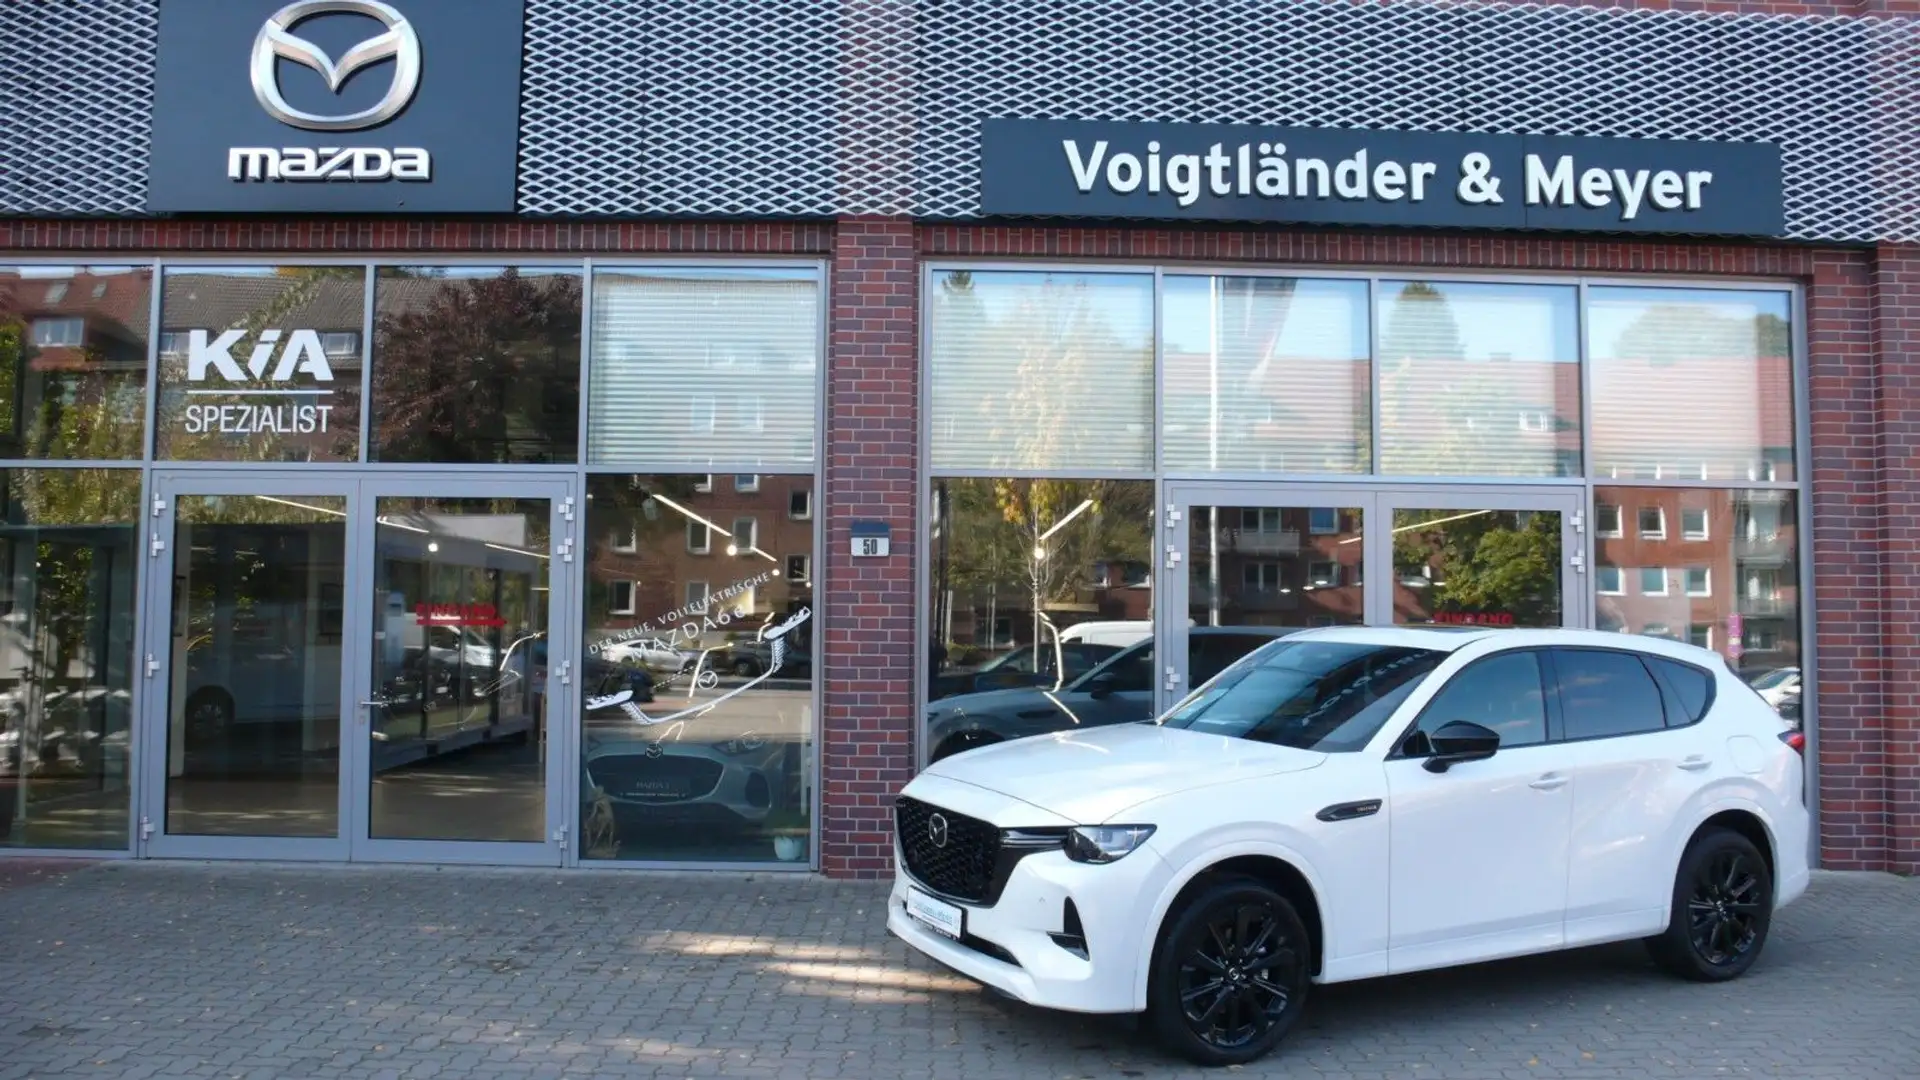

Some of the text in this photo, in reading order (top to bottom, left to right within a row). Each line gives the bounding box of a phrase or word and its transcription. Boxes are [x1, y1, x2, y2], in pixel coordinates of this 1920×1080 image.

[1062, 140, 1713, 220] Voigtländer & Meyer
[184, 404, 334, 433] SPEZIALIST
[862, 538, 878, 555] 50
[588, 637, 614, 655] DER
